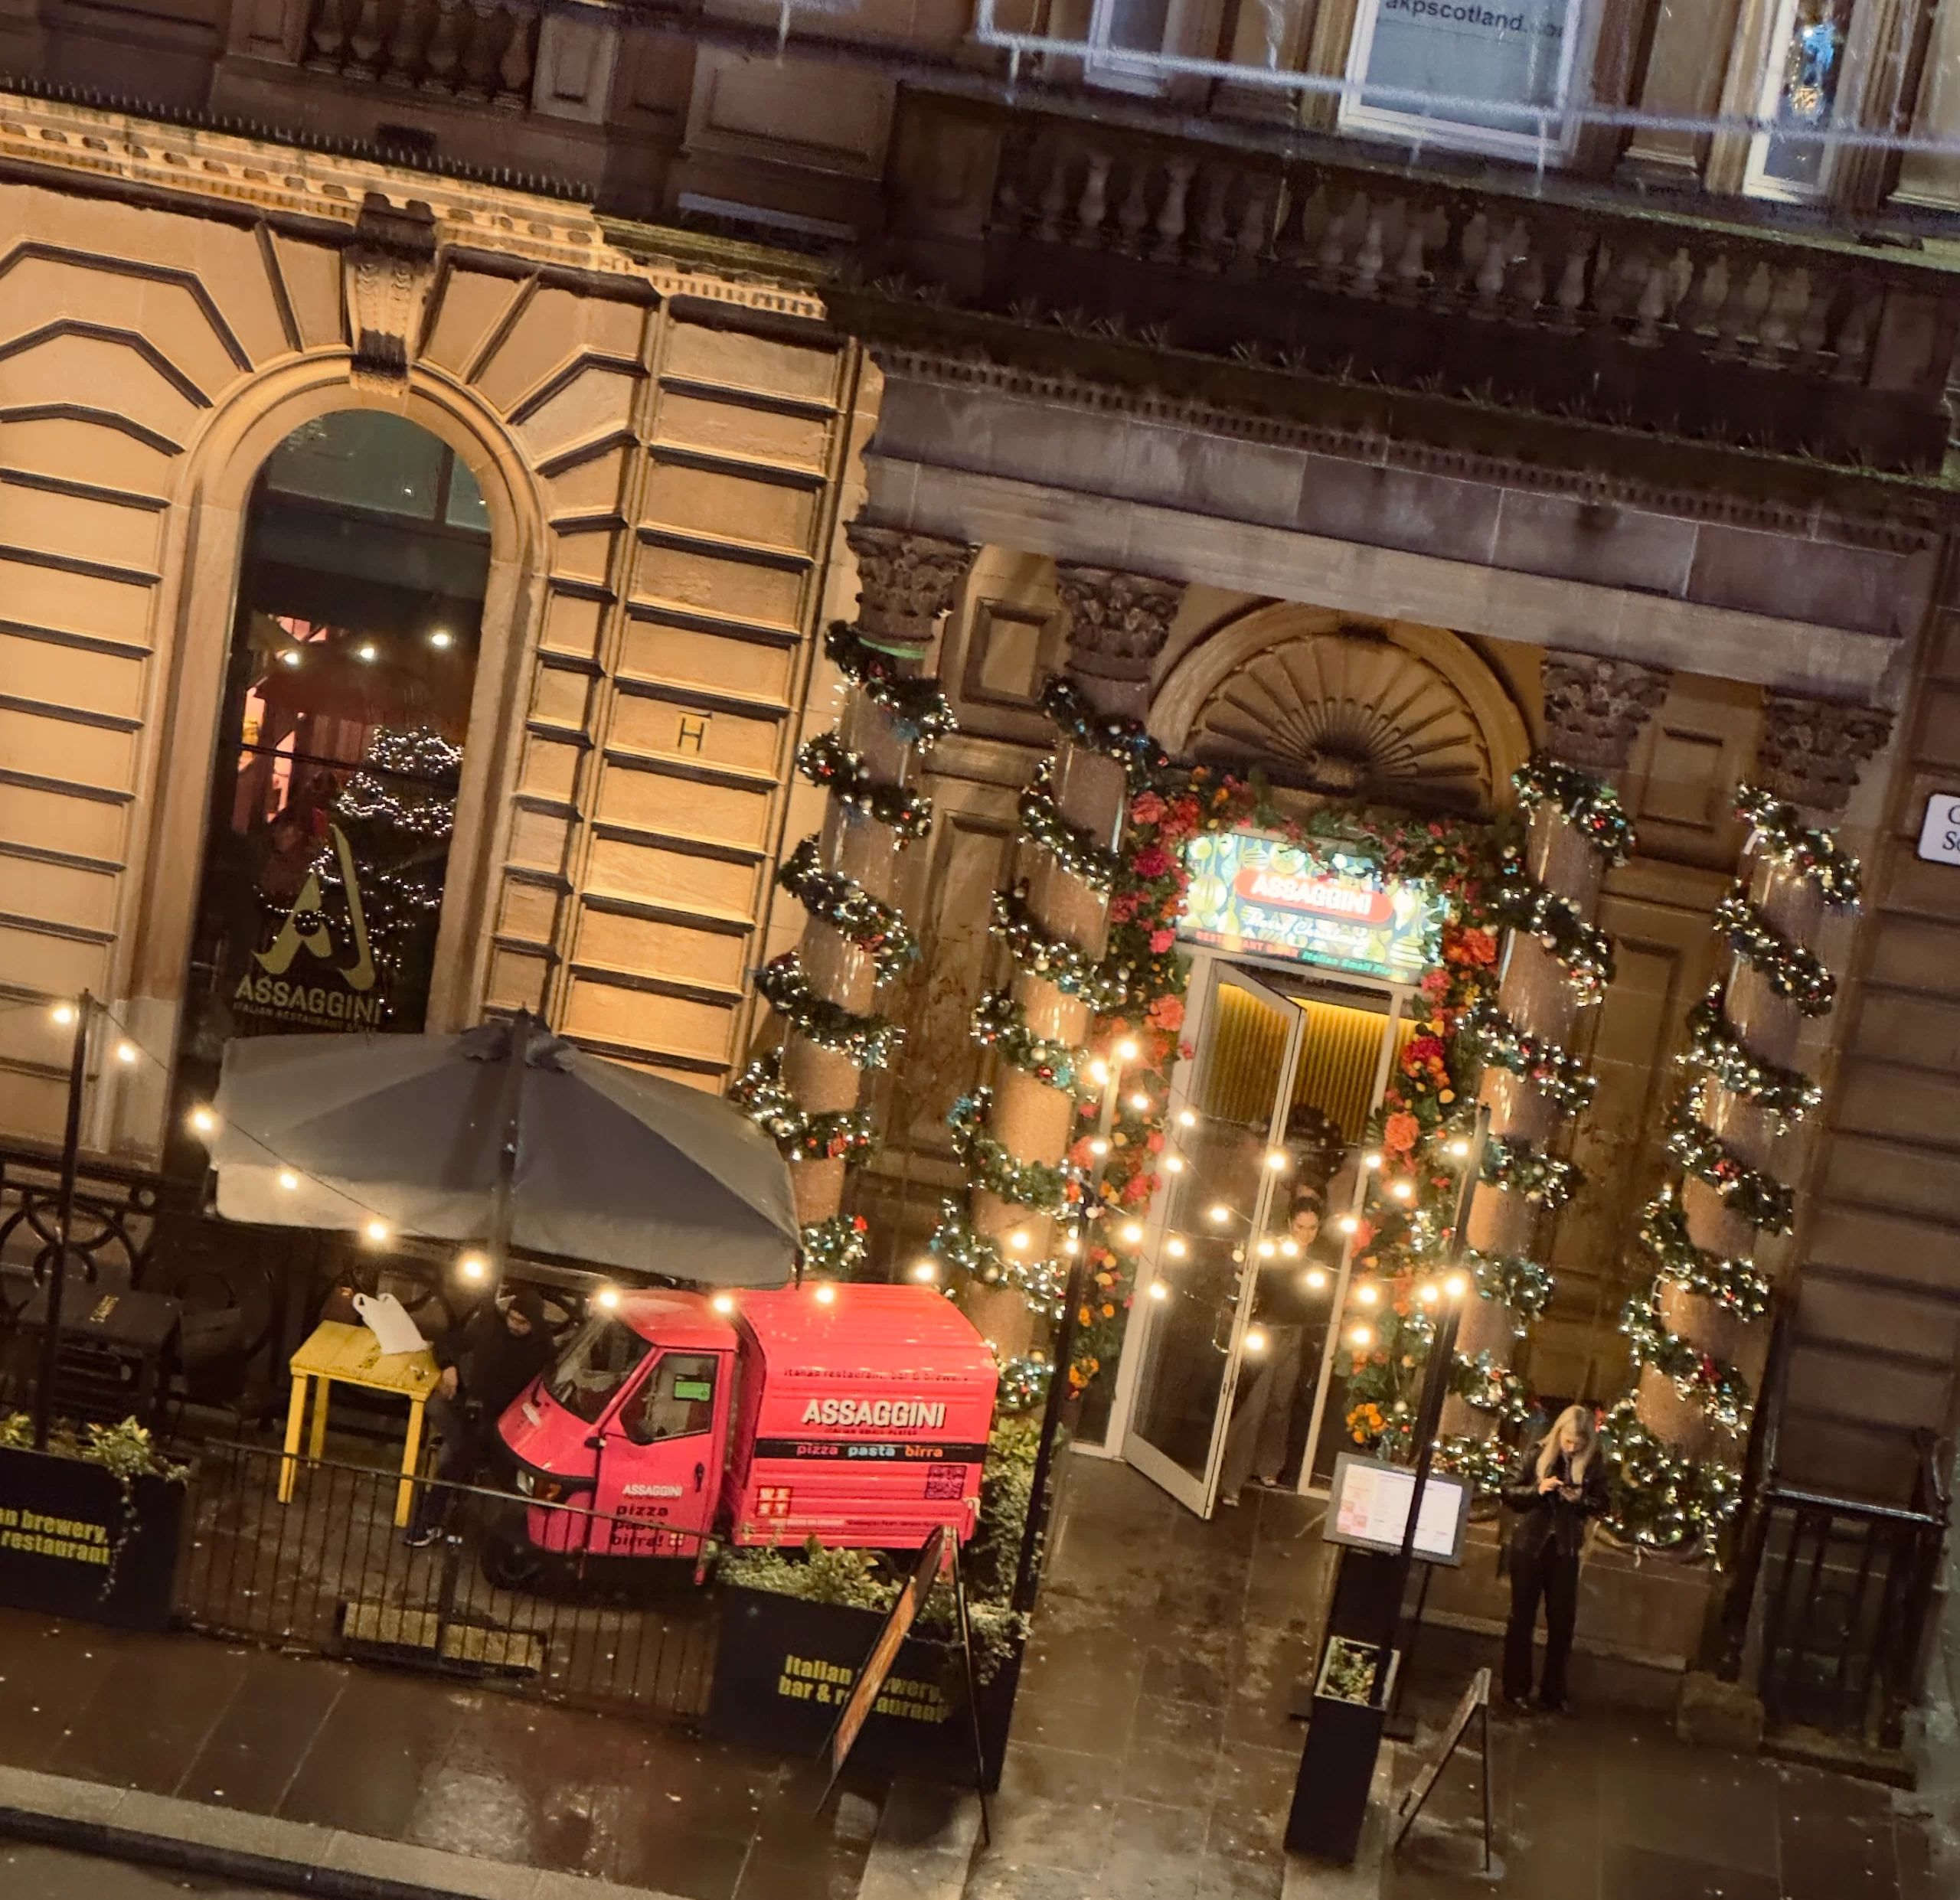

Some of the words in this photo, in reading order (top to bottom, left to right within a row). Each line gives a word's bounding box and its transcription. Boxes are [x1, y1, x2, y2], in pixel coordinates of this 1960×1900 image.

[1250, 873, 1373, 916] ASSAGGINI
[234, 973, 382, 1024] ASSAGGINI
[801, 1399, 946, 1428] ASSAGGINI
[796, 1444, 839, 1457] pizza
[847, 1445, 896, 1458] pasta
[905, 1445, 943, 1458] birra
[622, 1484, 683, 1497] ASSAGGINI
[616, 1503, 668, 1517] pizza
[21, 1509, 109, 1545] brewery,
[1, 1530, 111, 1565] restaurant
[785, 1654, 851, 1685] Italian
[779, 1675, 814, 1699] bar
[816, 1683, 831, 1703] &
